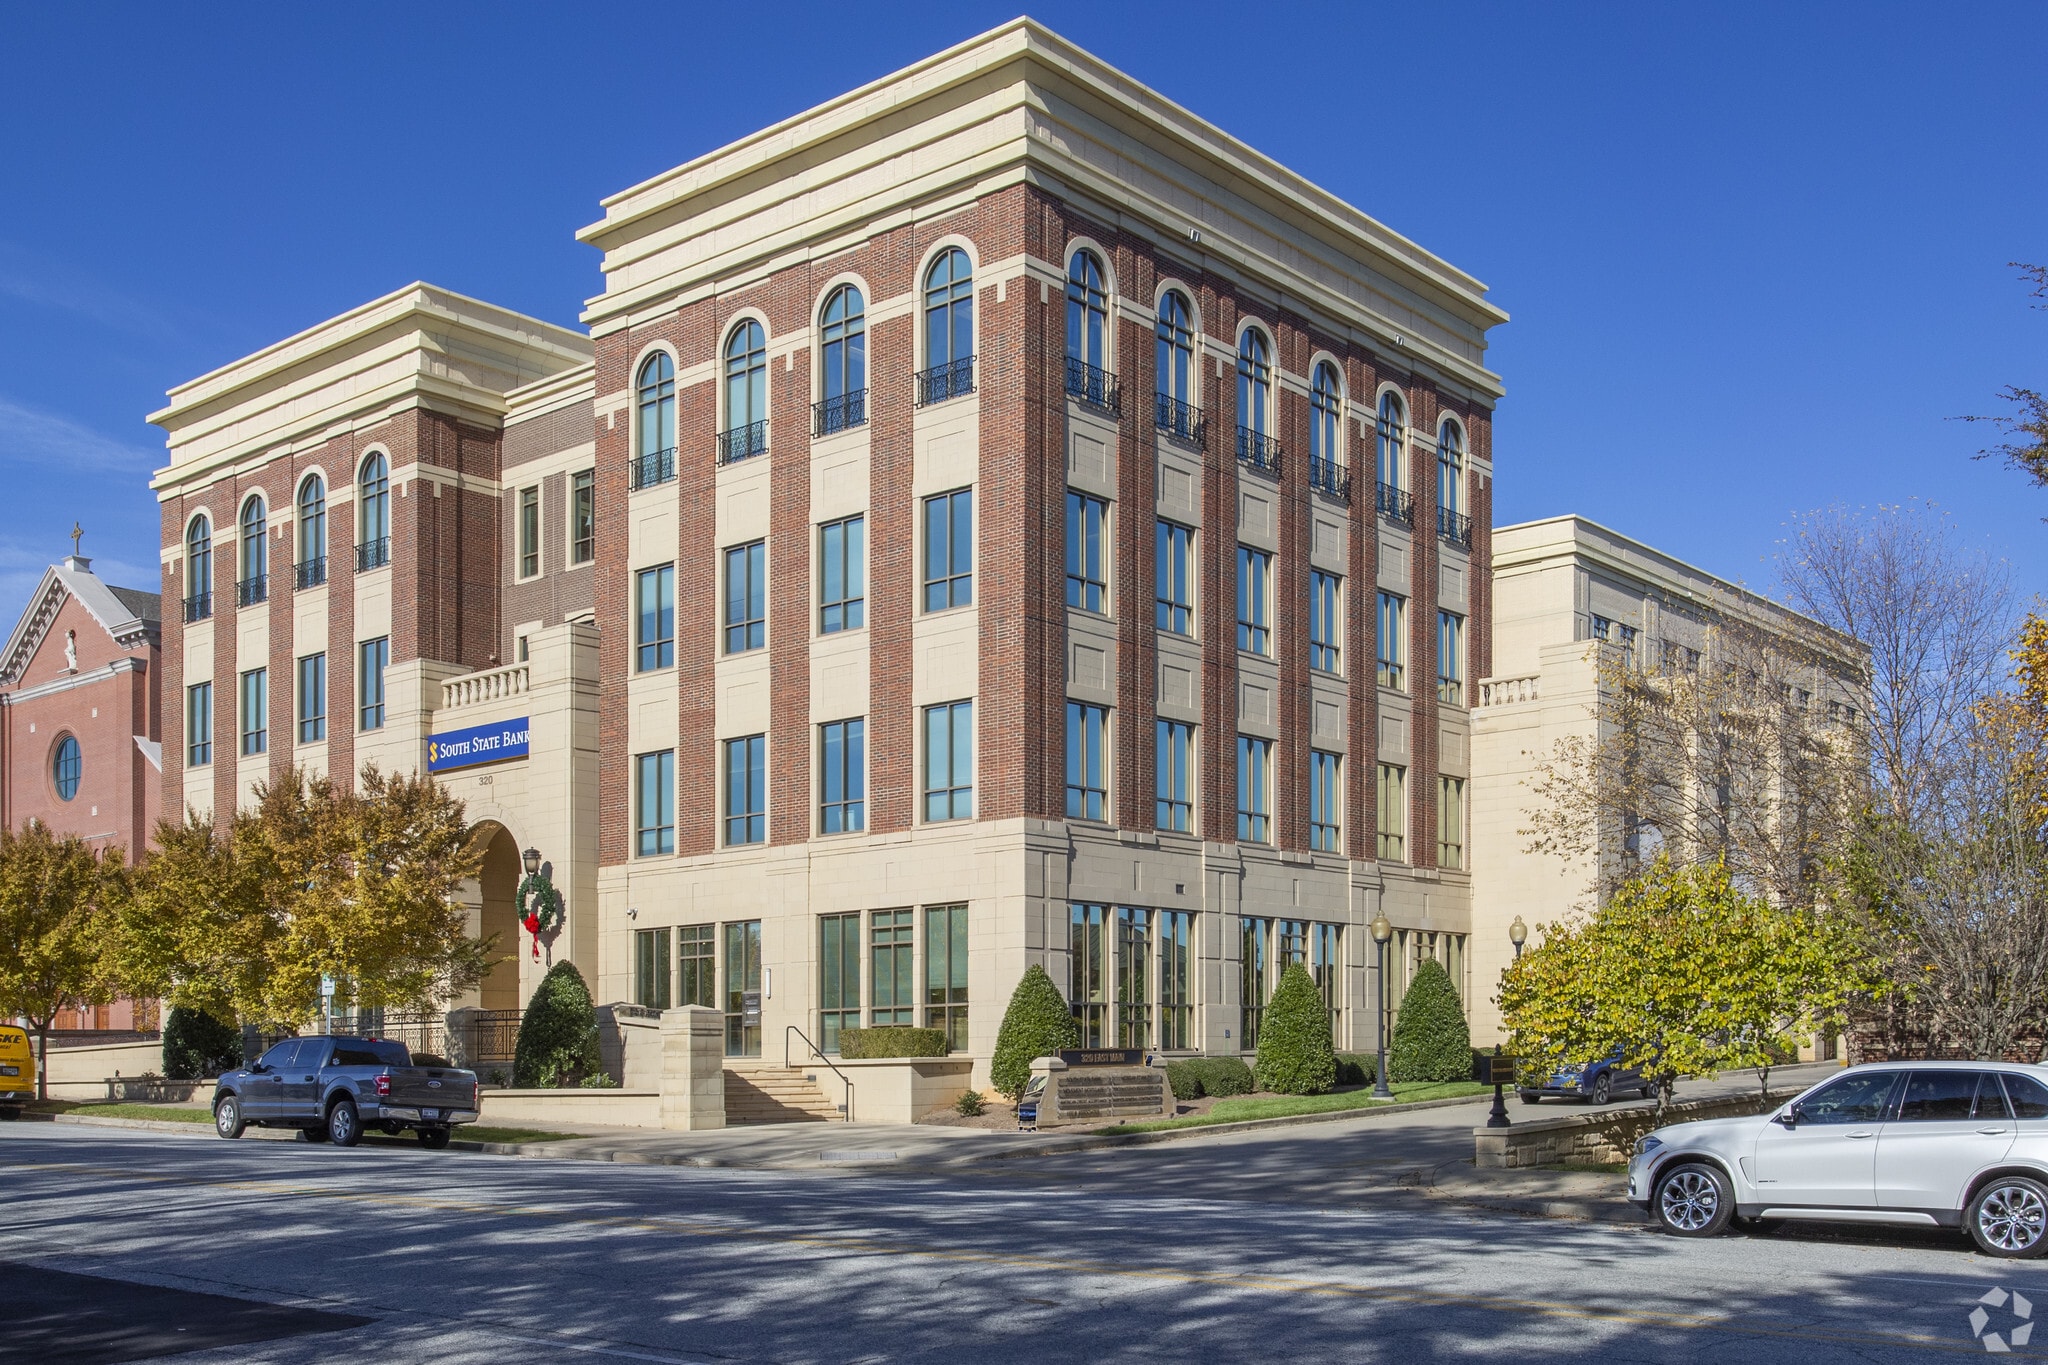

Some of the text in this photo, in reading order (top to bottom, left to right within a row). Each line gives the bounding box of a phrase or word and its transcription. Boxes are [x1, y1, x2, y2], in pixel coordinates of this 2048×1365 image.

[440, 729, 529, 758] SOUTH STATE BANK
[479, 775, 493, 786] 320
[1081, 1053, 1093, 1062] 320
[1094, 1053, 1108, 1062] EAST
